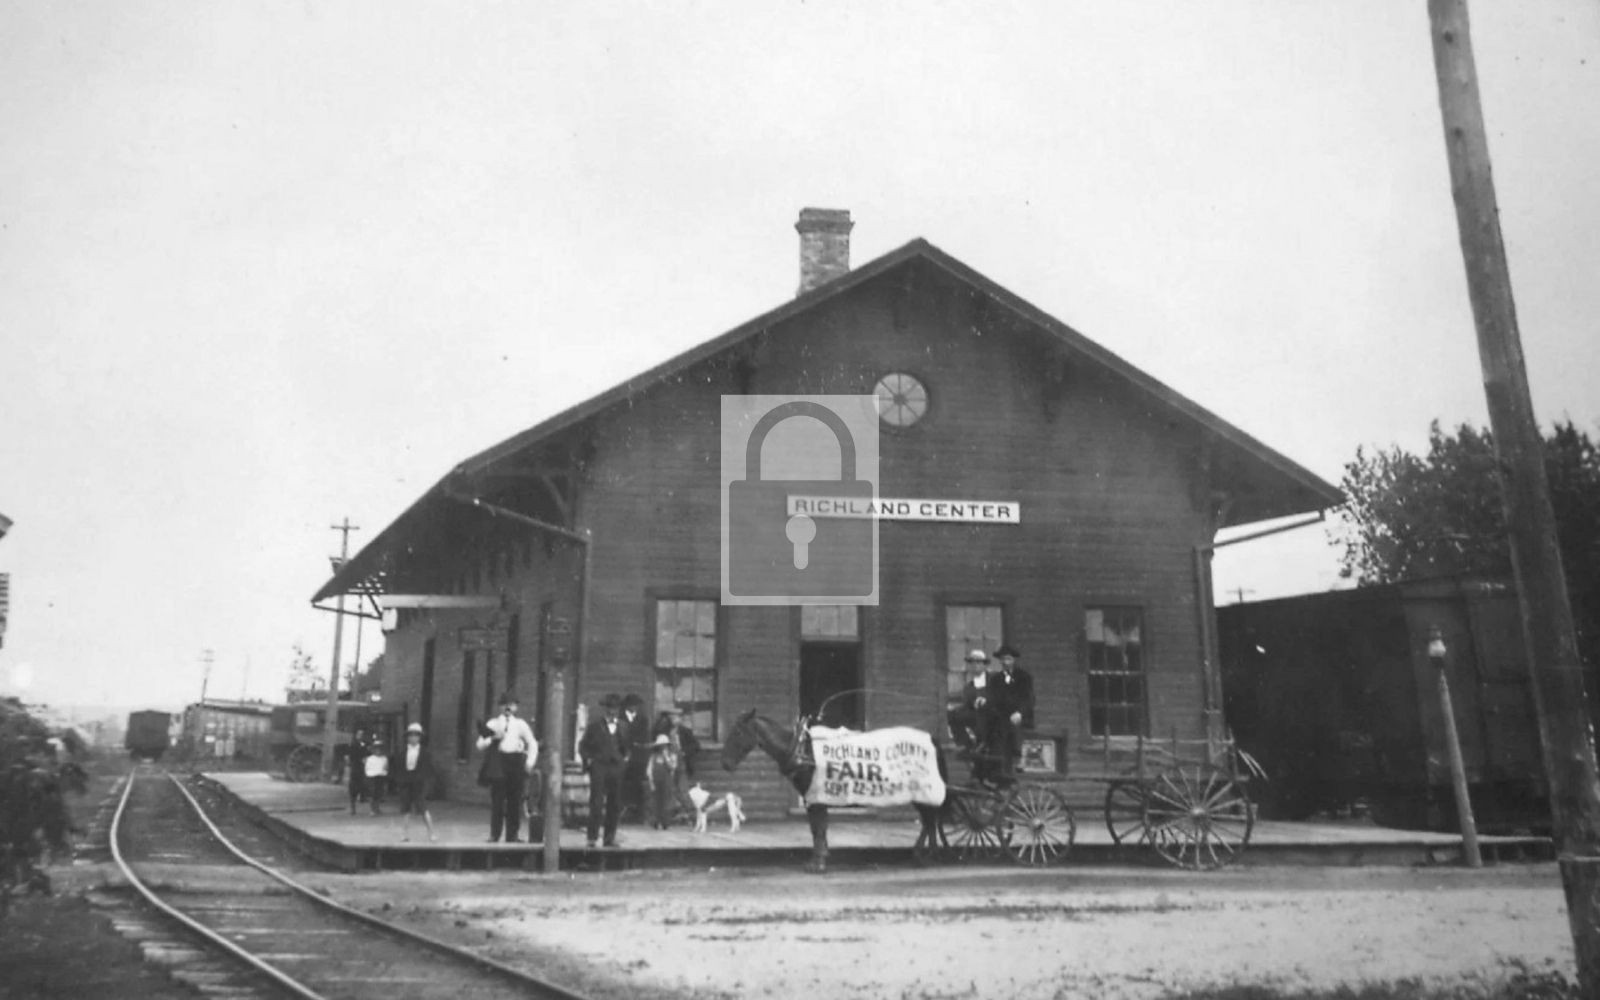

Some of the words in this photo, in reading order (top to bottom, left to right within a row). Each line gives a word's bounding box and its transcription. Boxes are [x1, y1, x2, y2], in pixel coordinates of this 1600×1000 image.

[794, 498, 911, 516] RICHLAND
[919, 502, 1012, 519] CENTER
[886, 741, 928, 761] COUNTY
[826, 761, 889, 782] FAIR.
